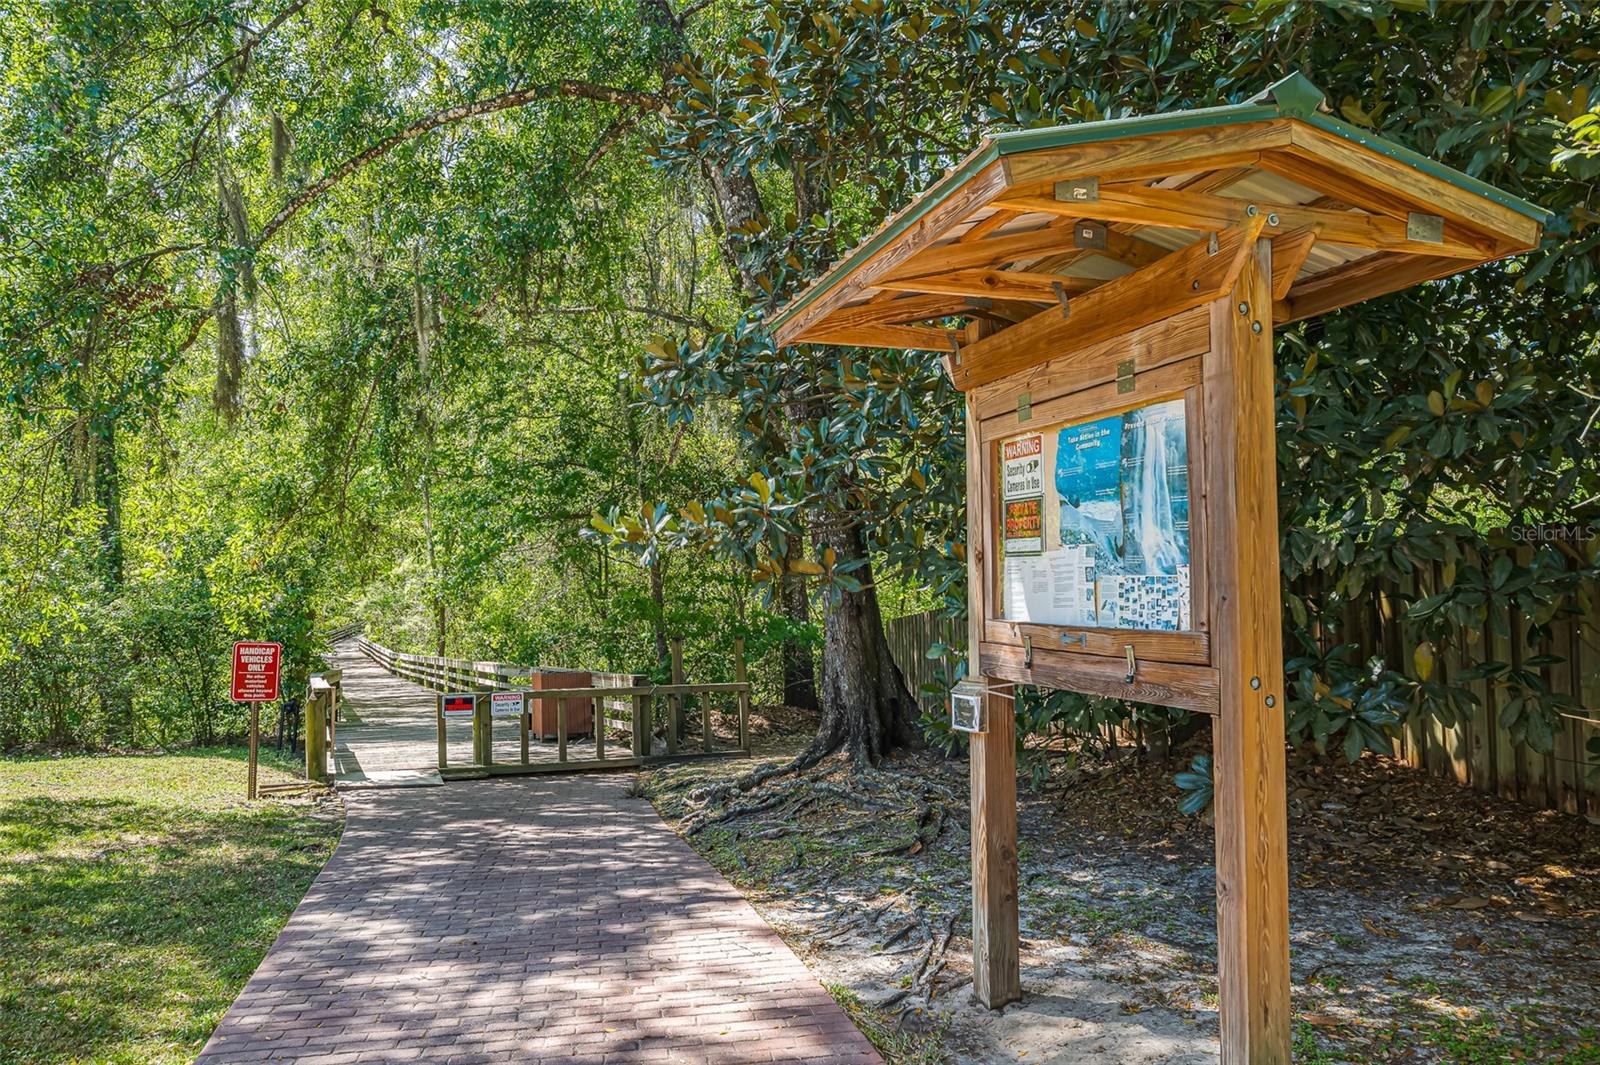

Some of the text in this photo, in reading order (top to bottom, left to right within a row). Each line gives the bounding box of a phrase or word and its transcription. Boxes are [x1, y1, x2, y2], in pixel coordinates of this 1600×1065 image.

[1005, 440, 1040, 459] WARNING
[1007, 462, 1025, 478] Security
[1007, 479, 1025, 493] Cameras
[1031, 476, 1040, 489] Use
[1007, 515, 1041, 530] PROPERTY
[240, 647, 275, 655] HANDICAP
[241, 655, 273, 663] VEHICLES
[494, 694, 521, 702] WARNING
